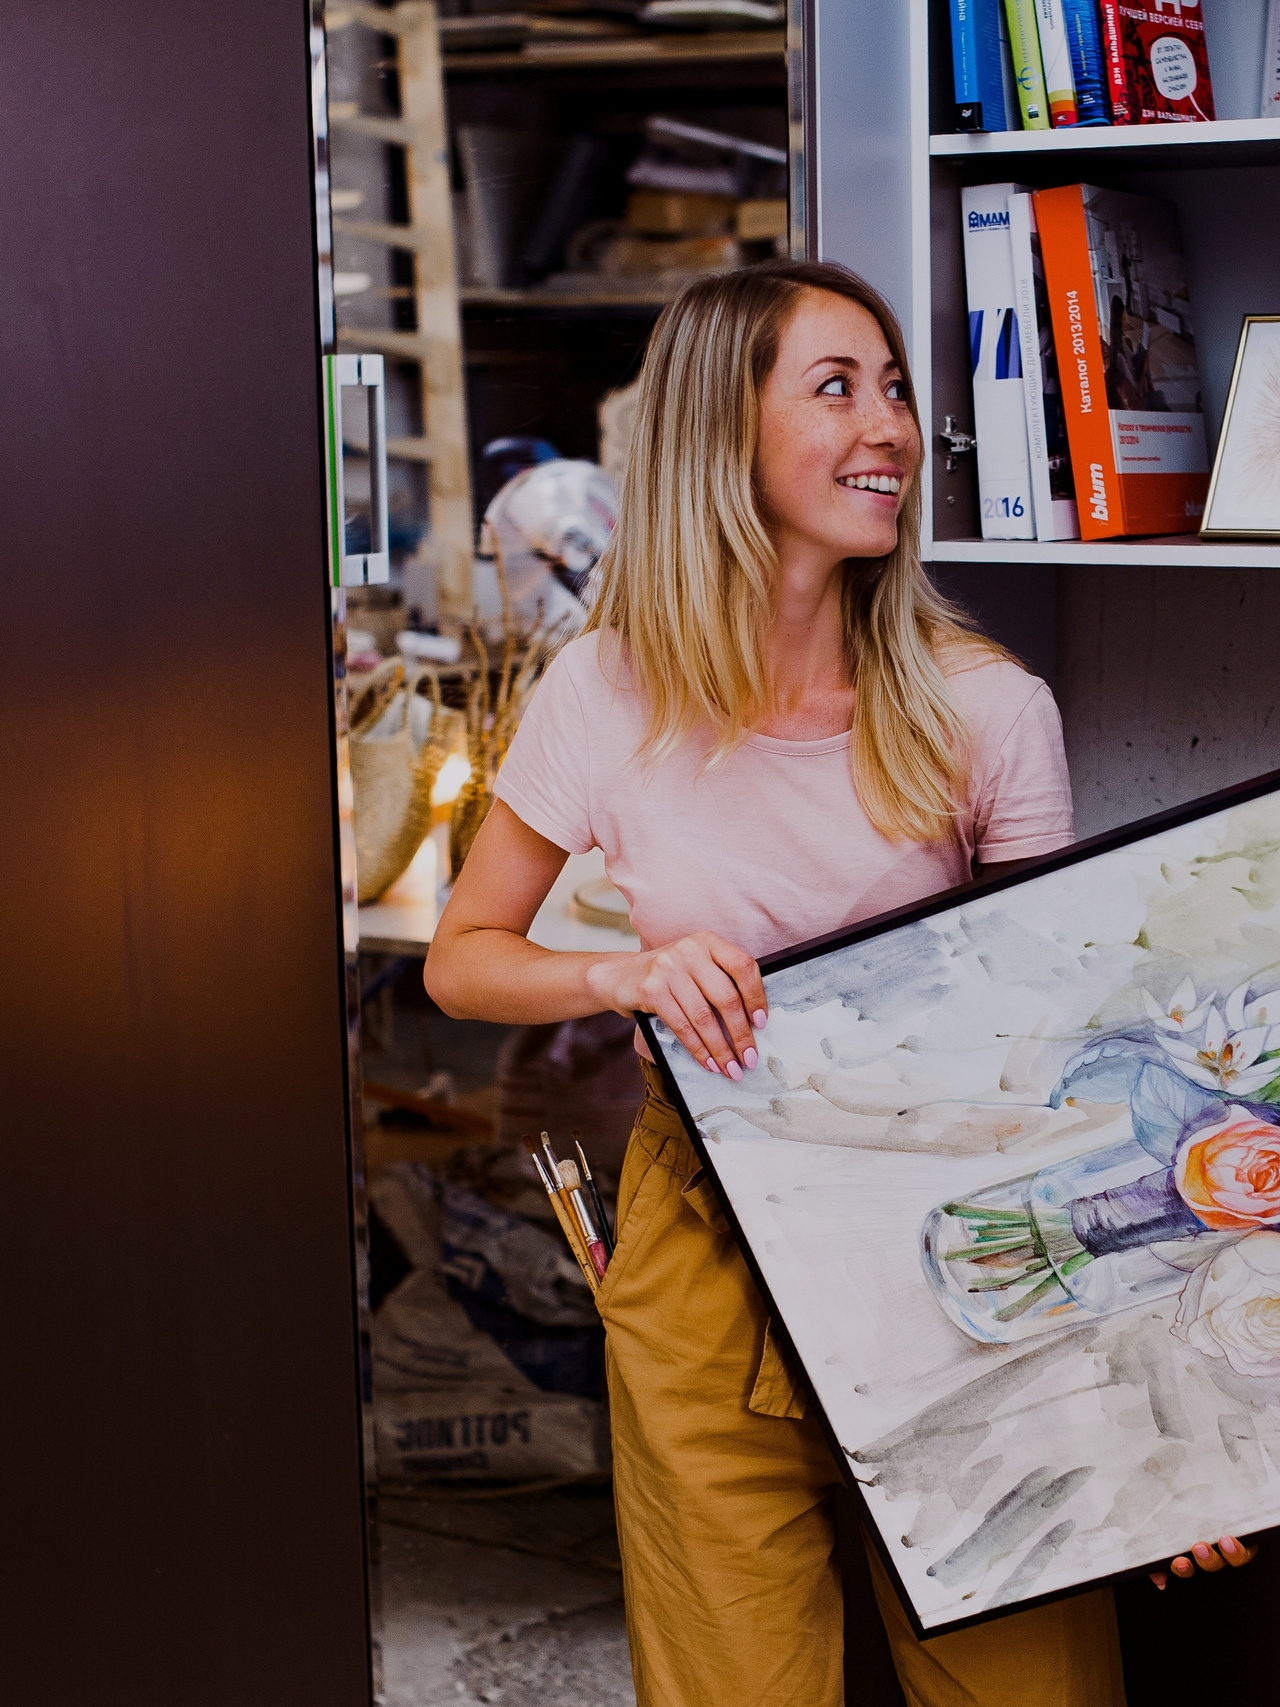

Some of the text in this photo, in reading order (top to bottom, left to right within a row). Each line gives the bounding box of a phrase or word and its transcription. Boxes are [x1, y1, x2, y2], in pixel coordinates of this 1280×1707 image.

[1112, 67, 1123, 85] ДЭН
[1020, 277, 1043, 460] КОМПЛЕКТУЮЩИЕ ДЛЯ МЕБЕЛИ 2018
[1066, 289, 1093, 414] Каталог 2013/2014
[983, 496, 1024, 519] 2016
[1089, 463, 1108, 521] blum
